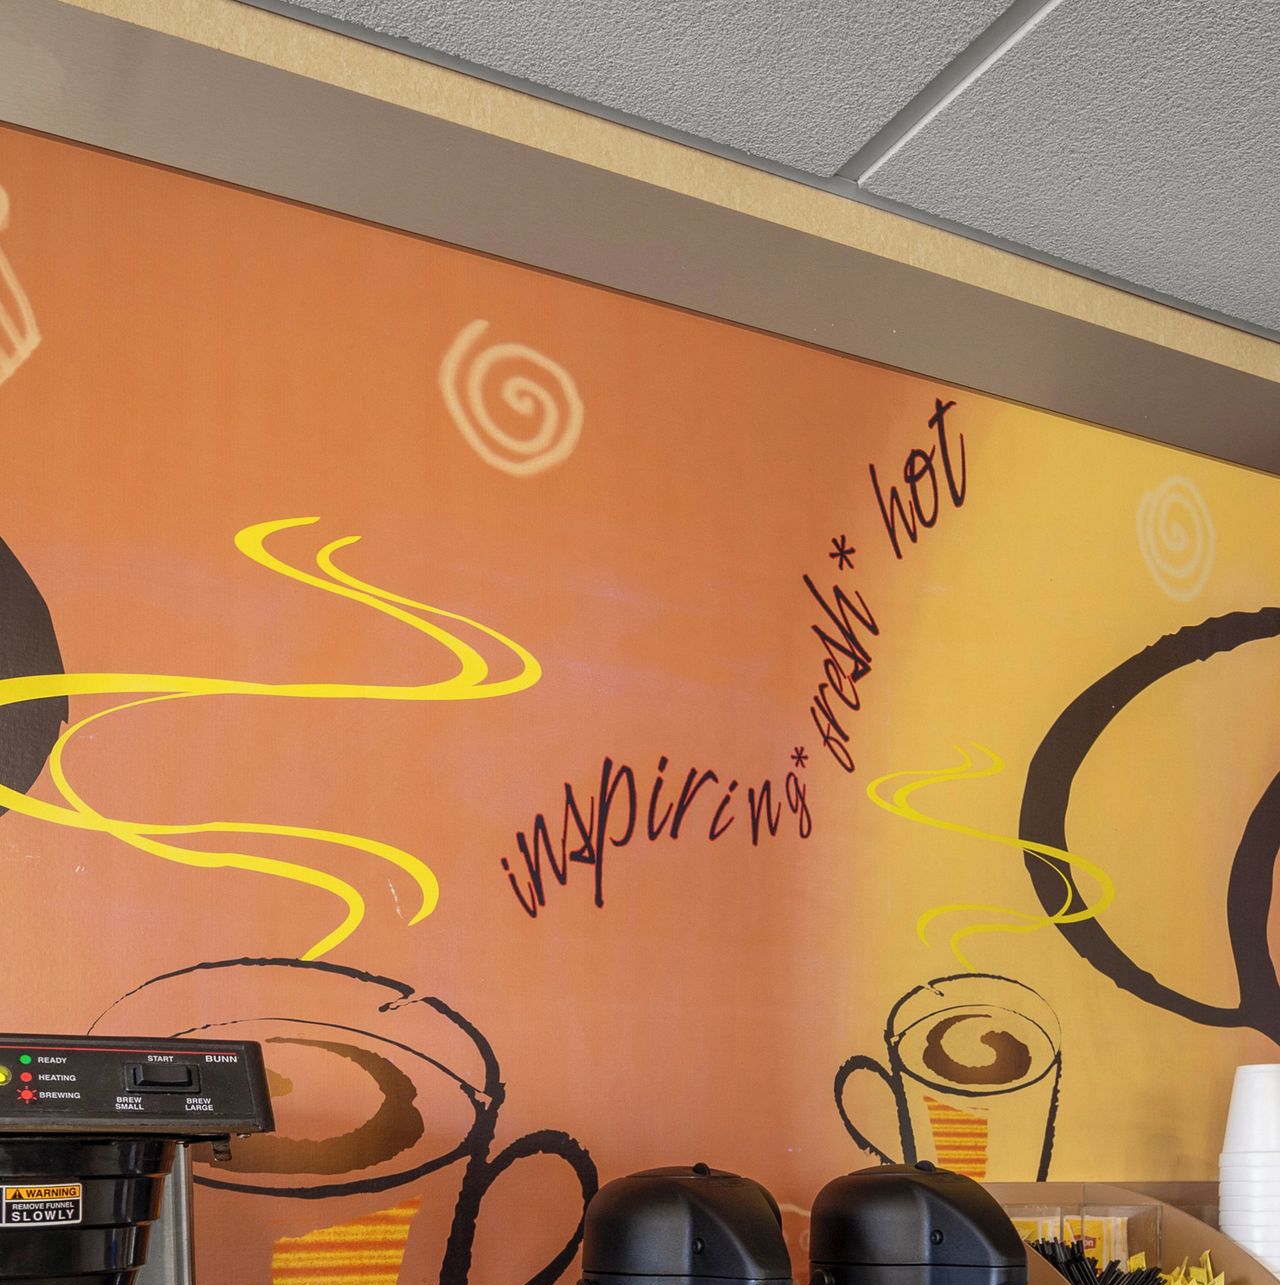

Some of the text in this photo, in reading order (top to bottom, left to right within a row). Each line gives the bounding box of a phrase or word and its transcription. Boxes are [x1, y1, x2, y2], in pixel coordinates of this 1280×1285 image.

[869, 398, 967, 560] hot
[37, 1056, 68, 1064] READY
[205, 1055, 238, 1063] BUNN
[38, 1074, 77, 1082] HEATING
[39, 1091, 81, 1099] BREWING
[26, 1188, 77, 1198] WARNING
[46, 1201, 74, 1209] FUNNEL
[11, 1209, 75, 1221] SLOWLY
